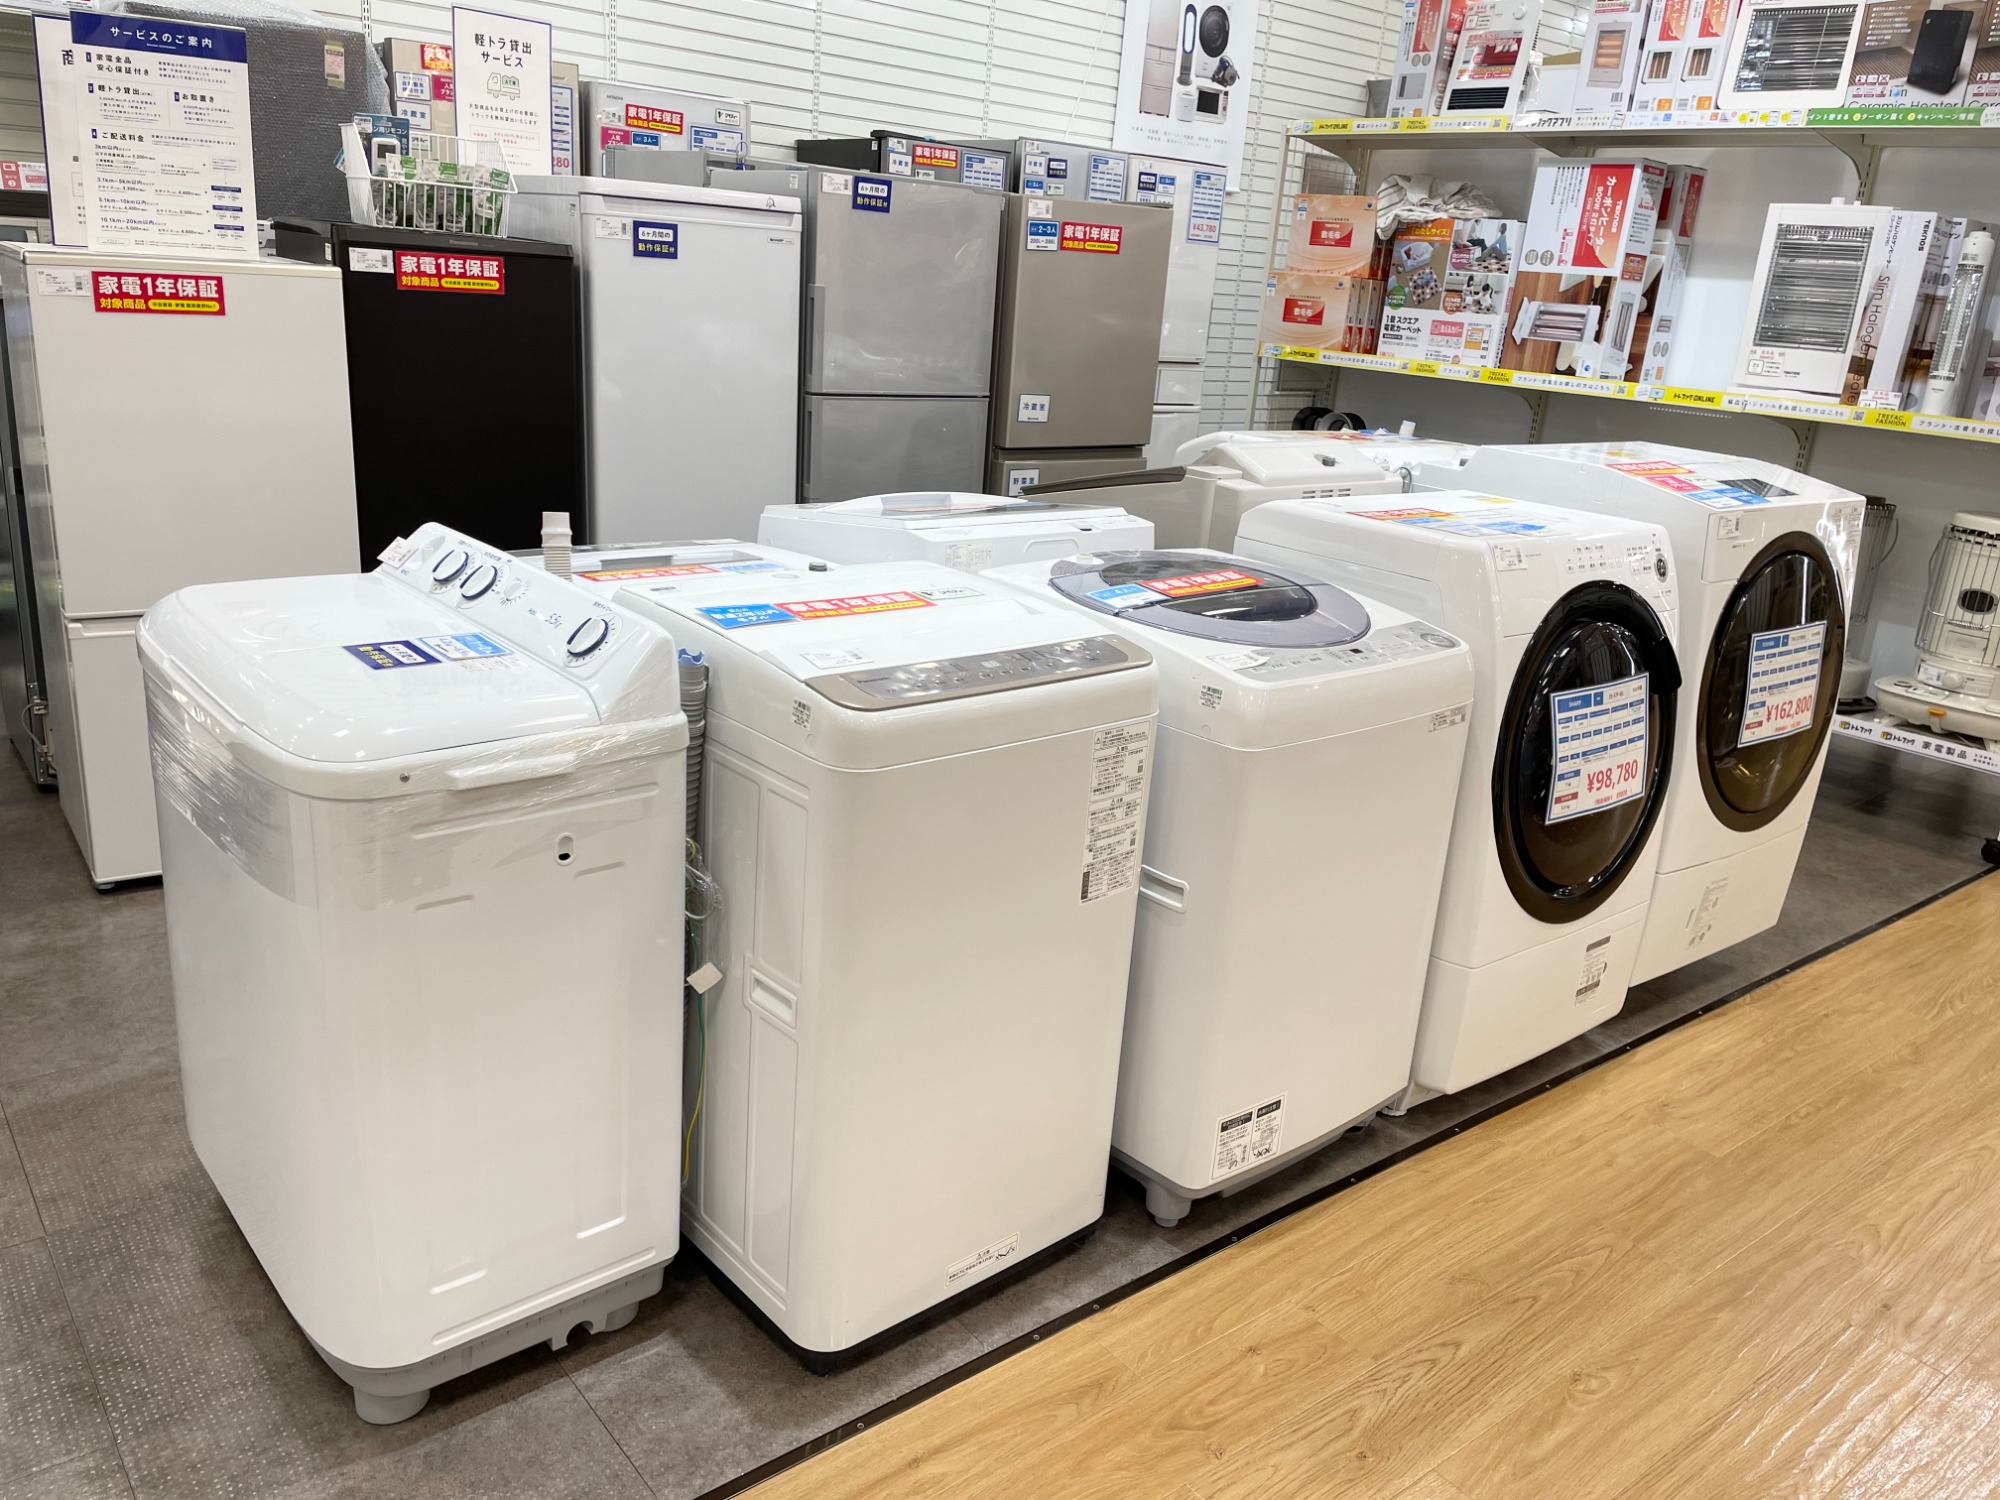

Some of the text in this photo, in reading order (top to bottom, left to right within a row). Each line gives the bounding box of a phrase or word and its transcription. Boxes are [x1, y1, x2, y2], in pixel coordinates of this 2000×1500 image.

[110, 26, 212, 48] サービスのご案内
[474, 32, 532, 55] 軽トラ貸出
[96, 53, 132, 65] 家電全品
[480, 52, 524, 68] サービス
[96, 64, 150, 76] 安心保証付き
[98, 84, 140, 96] 軽トラ貸出
[627, 105, 682, 126] 家電1年保証
[102, 131, 144, 142] ご配送料金
[915, 146, 957, 161] 家電1年保証
[1593, 186, 1604, 211] 900W
[1595, 176, 1618, 256] カーボンヒーター
[1064, 224, 1120, 242] 家電1年保証
[400, 255, 500, 278] 家電1年保証
[98, 275, 219, 298] 家電1年保証
[402, 276, 440, 288] 対象商品
[1873, 275, 1890, 302] Slim
[100, 298, 146, 310] 対象商品
[1384, 324, 1422, 334] 電気カーペット
[1858, 304, 1882, 360] Halogen
[1415, 366, 1436, 374] FASHION
[1416, 362, 1435, 370] TREFAC
[1488, 370, 1508, 378] TREFAC
[1022, 402, 1046, 412] 冷蔵室
[1875, 418, 1906, 427] FASHION
[1878, 412, 1904, 421] TREFAC
[1012, 477, 1036, 486] 野菜室
[1152, 570, 1246, 589] 家電1年保証
[784, 592, 916, 612] 家電1年保証
[1766, 694, 1812, 723] ¥162,800
[1850, 724, 1873, 735] トレファク
[1892, 734, 1916, 746] トレファク
[1921, 740, 1968, 760] 家電製品
[1586, 758, 1638, 794] ¥98,780
